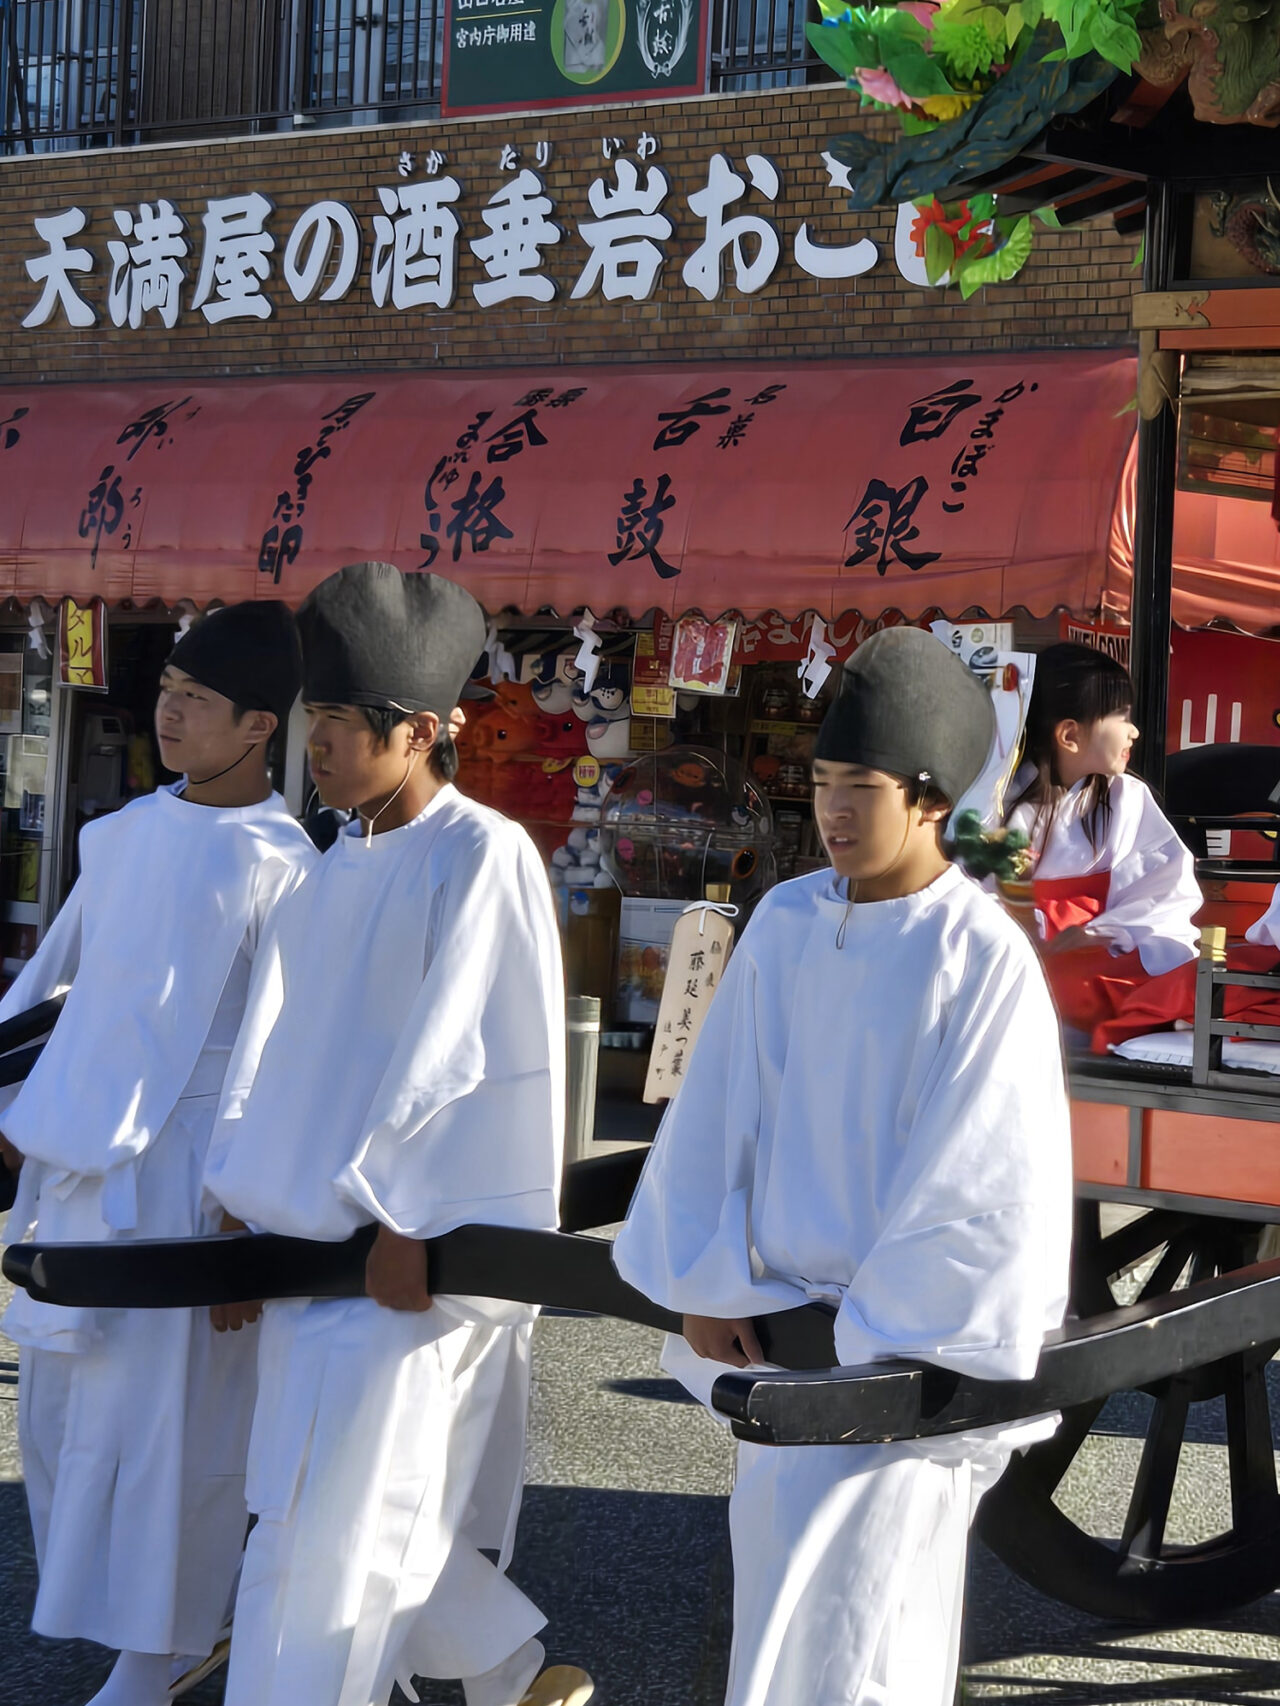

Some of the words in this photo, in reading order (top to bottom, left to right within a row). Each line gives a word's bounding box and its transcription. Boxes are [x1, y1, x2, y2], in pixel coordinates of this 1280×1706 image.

[398, 150, 445, 177] さか
[500, 143, 551, 170] たり
[602, 131, 658, 160] いわ
[446, 408, 549, 563] 合格
[607, 387, 733, 579] 舌鼓
[842, 378, 982, 577] 白銀
[941, 380, 1041, 513] かまぼこ
